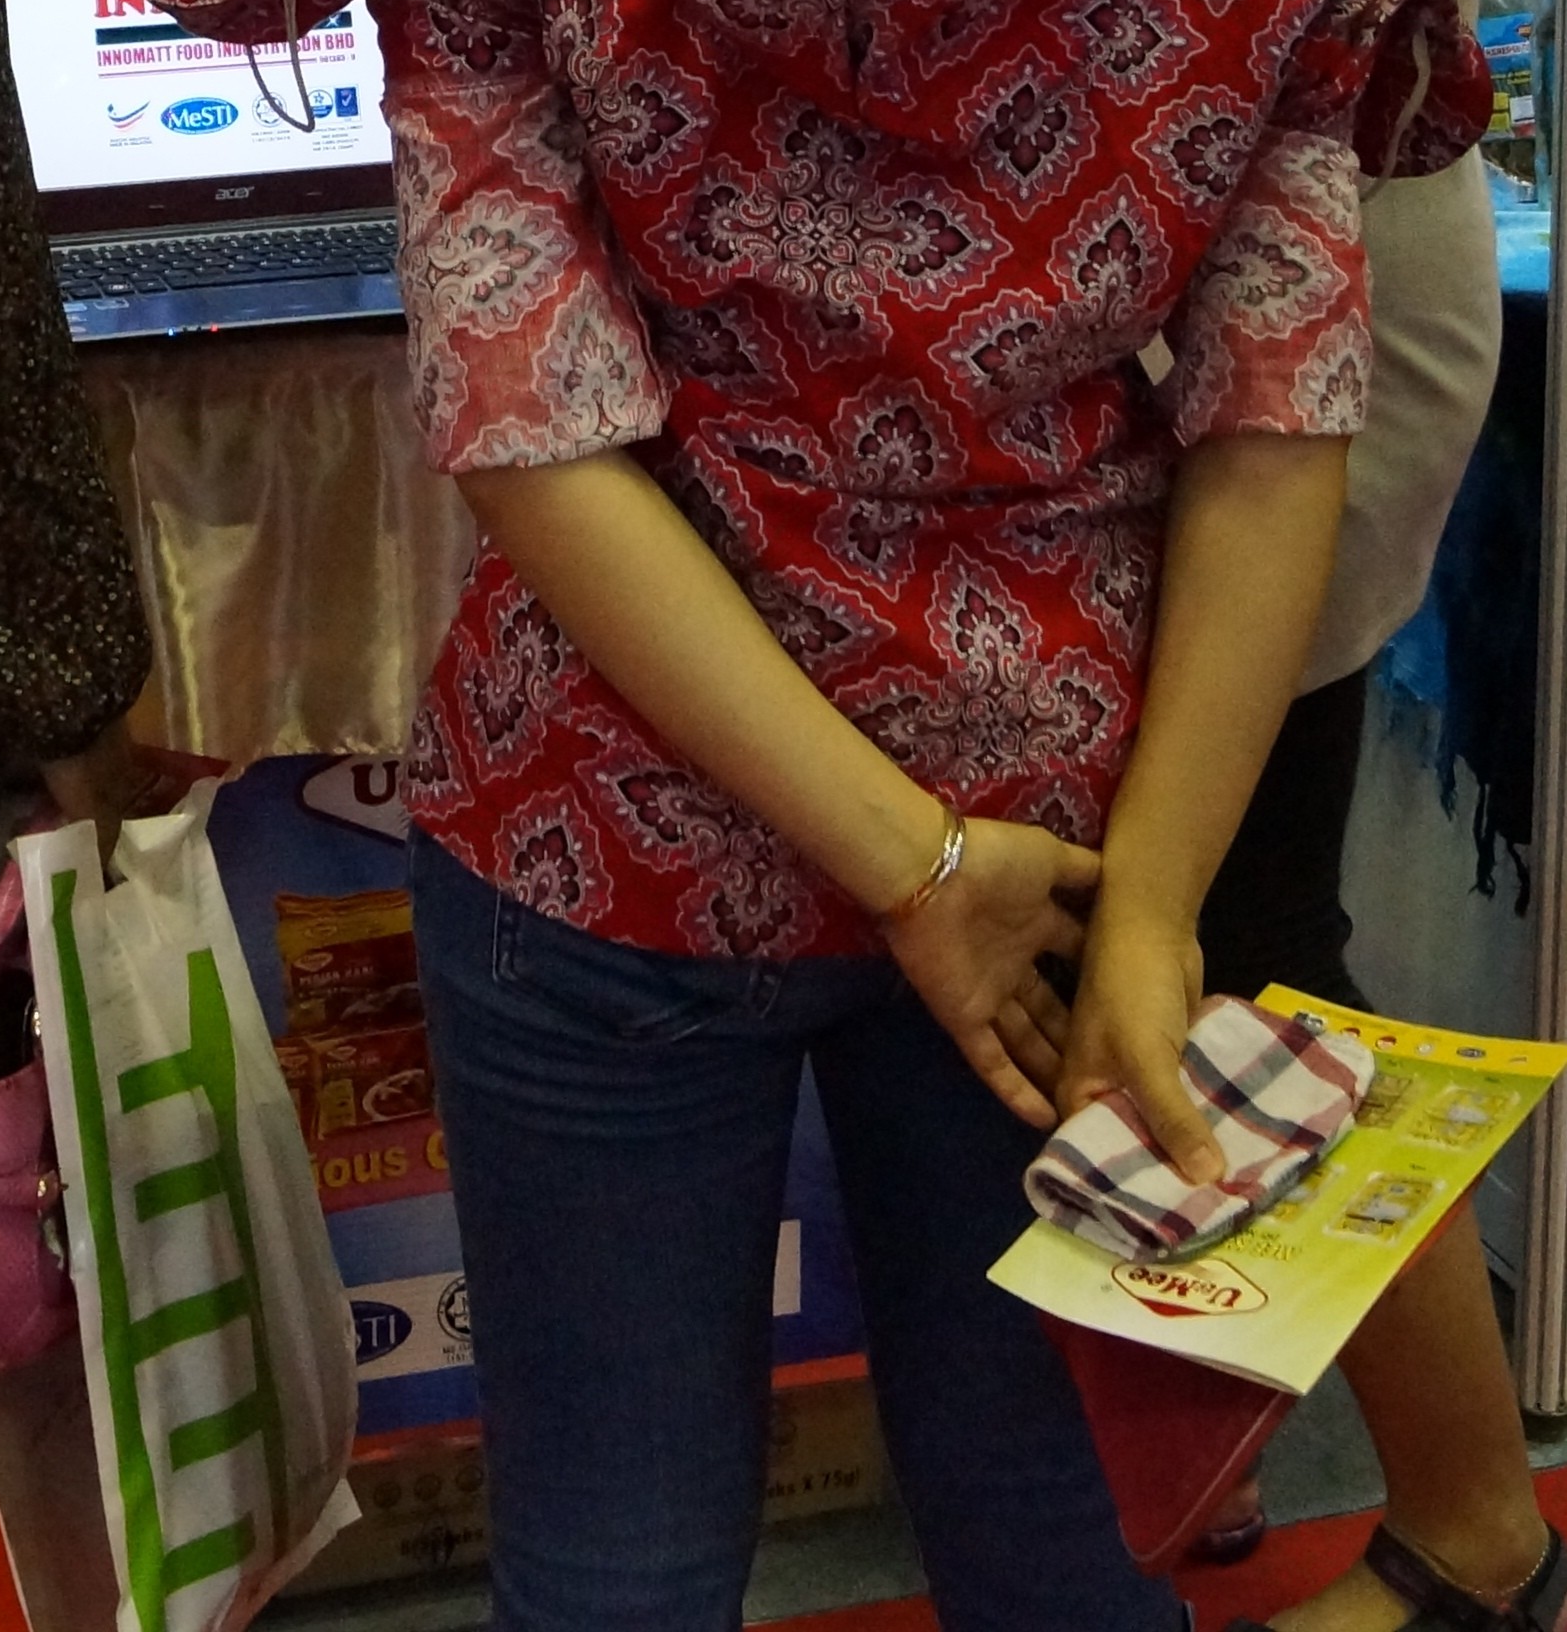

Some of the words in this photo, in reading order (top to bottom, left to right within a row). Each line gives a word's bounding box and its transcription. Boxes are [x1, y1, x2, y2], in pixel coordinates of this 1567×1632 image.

[97, 44, 173, 67] INNOMATT
[176, 42, 214, 62] FOOD
[325, 32, 356, 50] BHD
[167, 104, 233, 133] MeSTI
